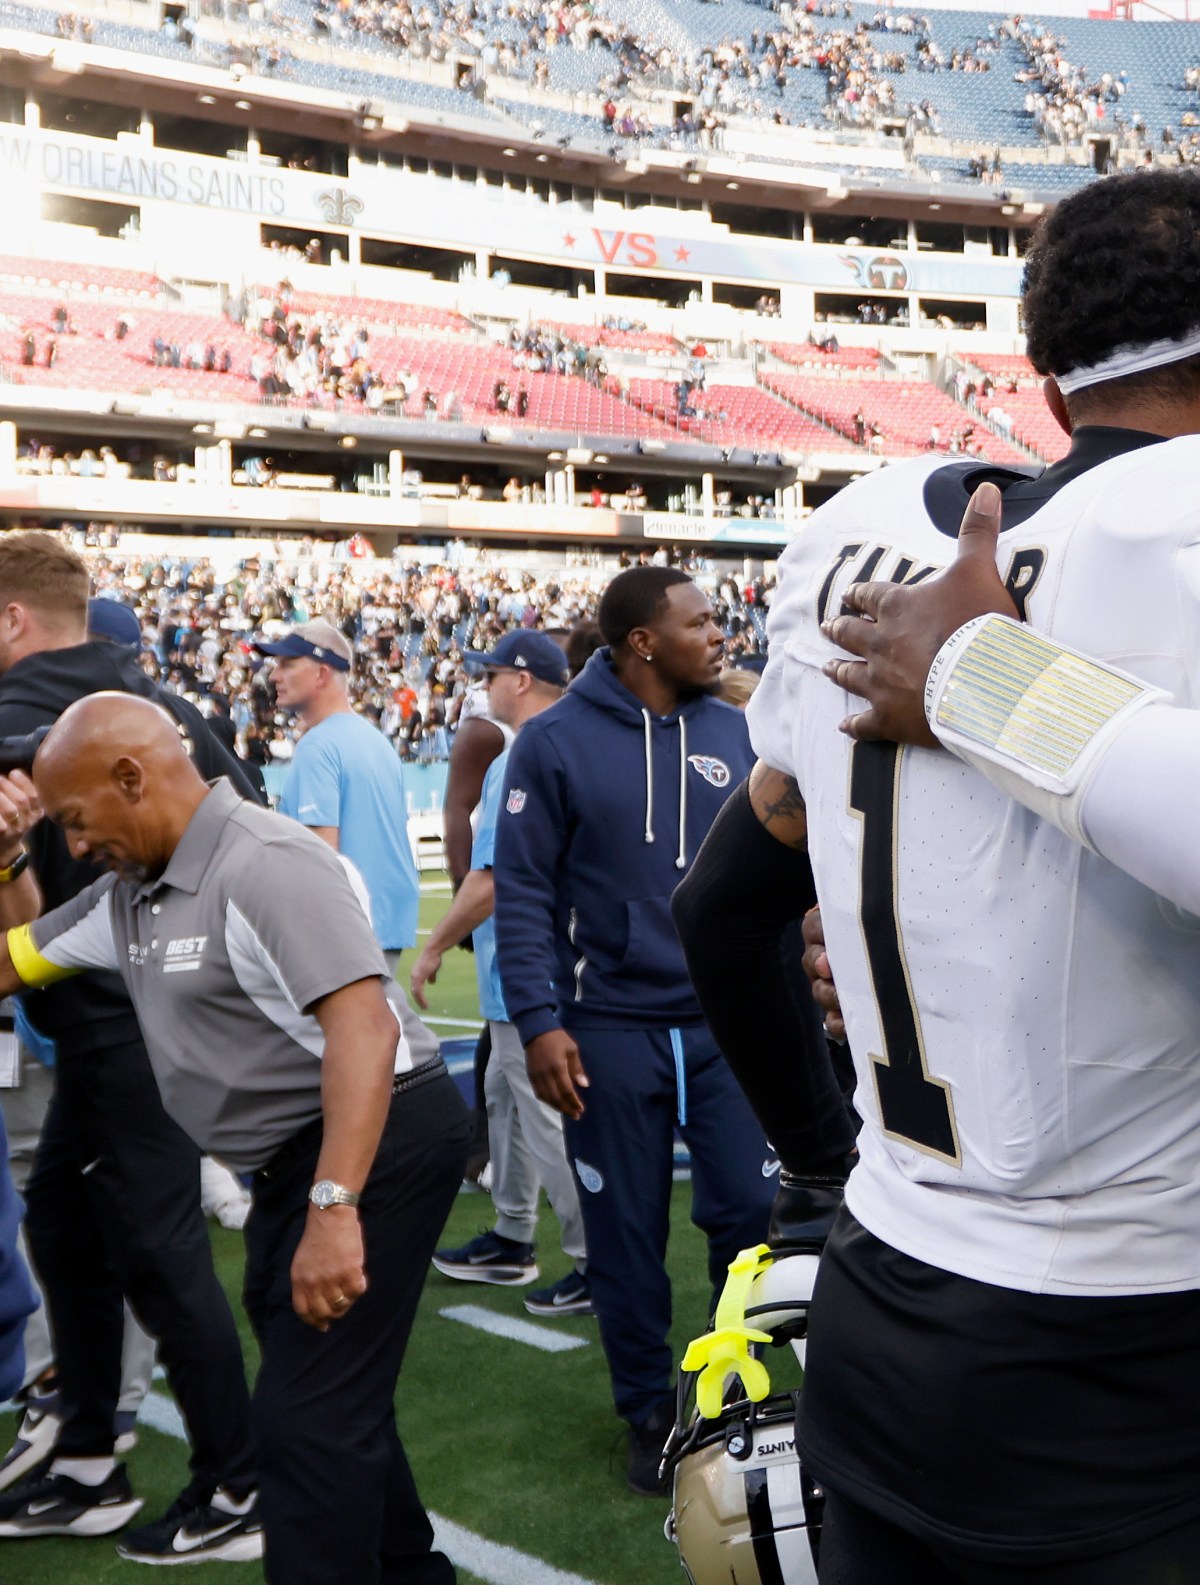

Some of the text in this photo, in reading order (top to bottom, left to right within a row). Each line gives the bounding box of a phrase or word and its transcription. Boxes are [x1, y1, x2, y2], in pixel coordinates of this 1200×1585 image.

[42, 142, 179, 201] ORLEANS
[187, 165, 286, 216] SAINTS
[592, 227, 658, 268] VS
[926, 656, 944, 698] HYPE
[165, 936, 207, 956] BEST
[847, 739, 962, 1169] 1
[757, 1439, 796, 1457] AINTS
